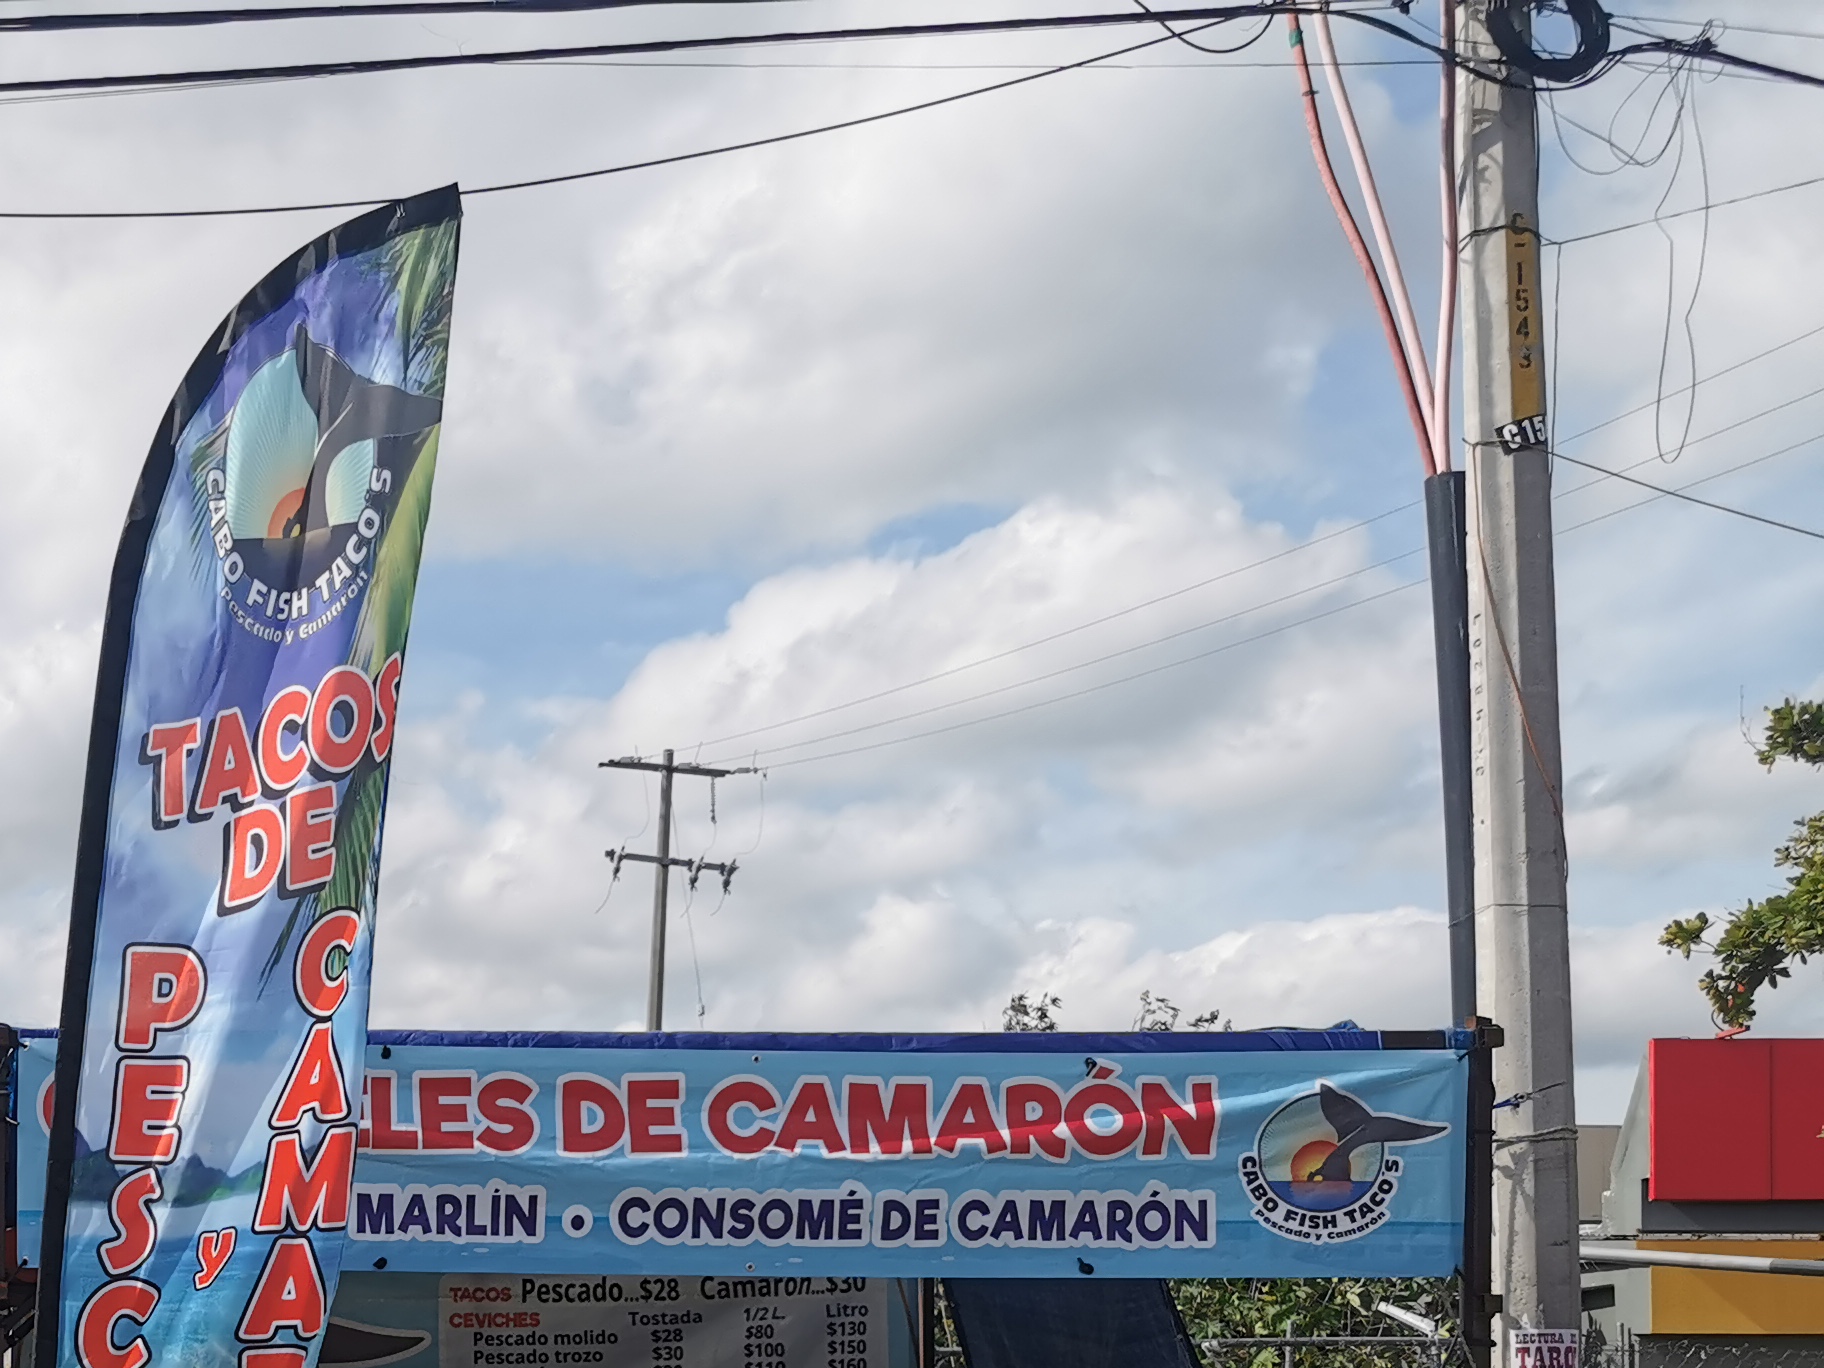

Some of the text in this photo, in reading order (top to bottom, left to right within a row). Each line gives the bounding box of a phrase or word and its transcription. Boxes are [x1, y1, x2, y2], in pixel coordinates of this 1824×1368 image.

[206, 468, 244, 583] CABO
[246, 579, 309, 620] FISH
[221, 586, 282, 643] Pescado
[285, 630, 294, 645] y
[148, 654, 402, 824] TACOS
[224, 782, 336, 909] DE
[562, 1079, 681, 1154] DE
[708, 1066, 1217, 1158] CAMARÓN
[357, 1182, 1208, 1245] MARLÍN CONSOMÉ DE CAMARÓN
[1242, 1156, 1279, 1213] CABO
[1283, 1209, 1337, 1229] FISH
[1255, 1209, 1386, 1241] Pescado y Camarón
[193, 1226, 237, 1291] y
[448, 1312, 541, 1329] CEVICHES
[628, 1309, 703, 1327] Tostada
[826, 1303, 869, 1319] Litro
[449, 1287, 512, 1303] TACOS
[473, 1321, 867, 1347] Pescado molido $28 $80 $130
[473, 1339, 867, 1365] Pescado trozo $30 $100 $150
[1515, 1333, 1564, 1344] LECTURA
